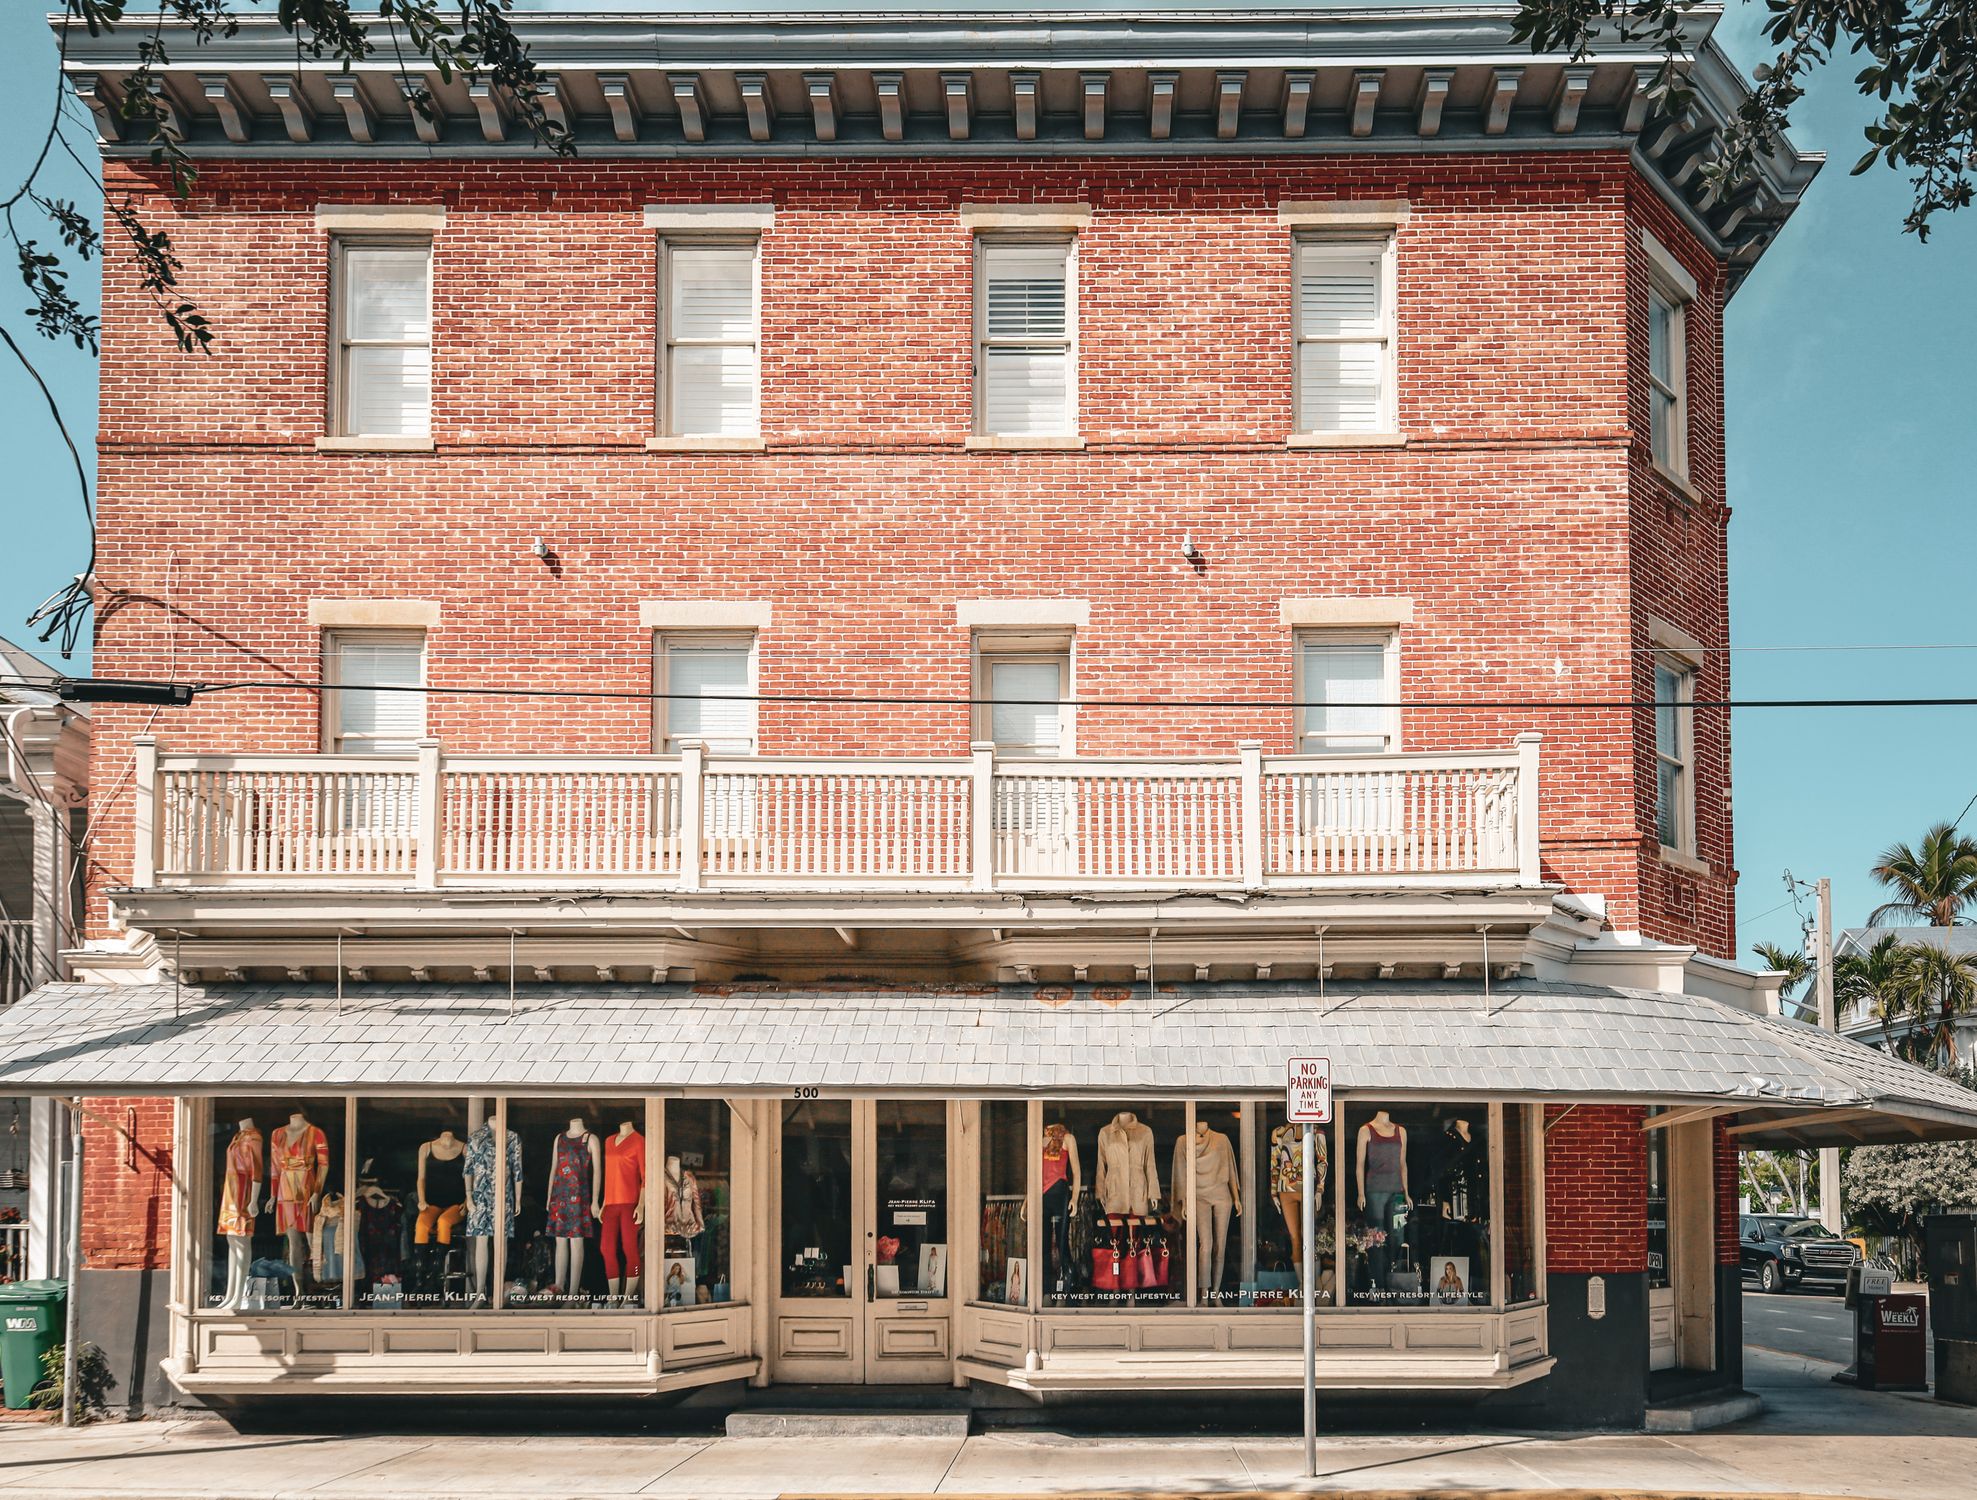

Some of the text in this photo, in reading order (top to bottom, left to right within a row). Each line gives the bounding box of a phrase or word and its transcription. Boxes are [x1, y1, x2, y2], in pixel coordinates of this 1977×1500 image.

[1301, 1063, 1317, 1075] NO
[1290, 1077, 1328, 1090] PARKING
[794, 1087, 819, 1099] 500
[1300, 1091, 1318, 1099] ANY
[1299, 1100, 1320, 1109] TIME
[359, 1291, 487, 1302] JEAN-PIERRE KLIFA
[1202, 1288, 1331, 1300] JEAN-PIERRE KLFA
[1353, 1291, 1484, 1299] KEY WEST RESORT LIFESTYLE
[1881, 1310, 1920, 1326] WEEKLY
